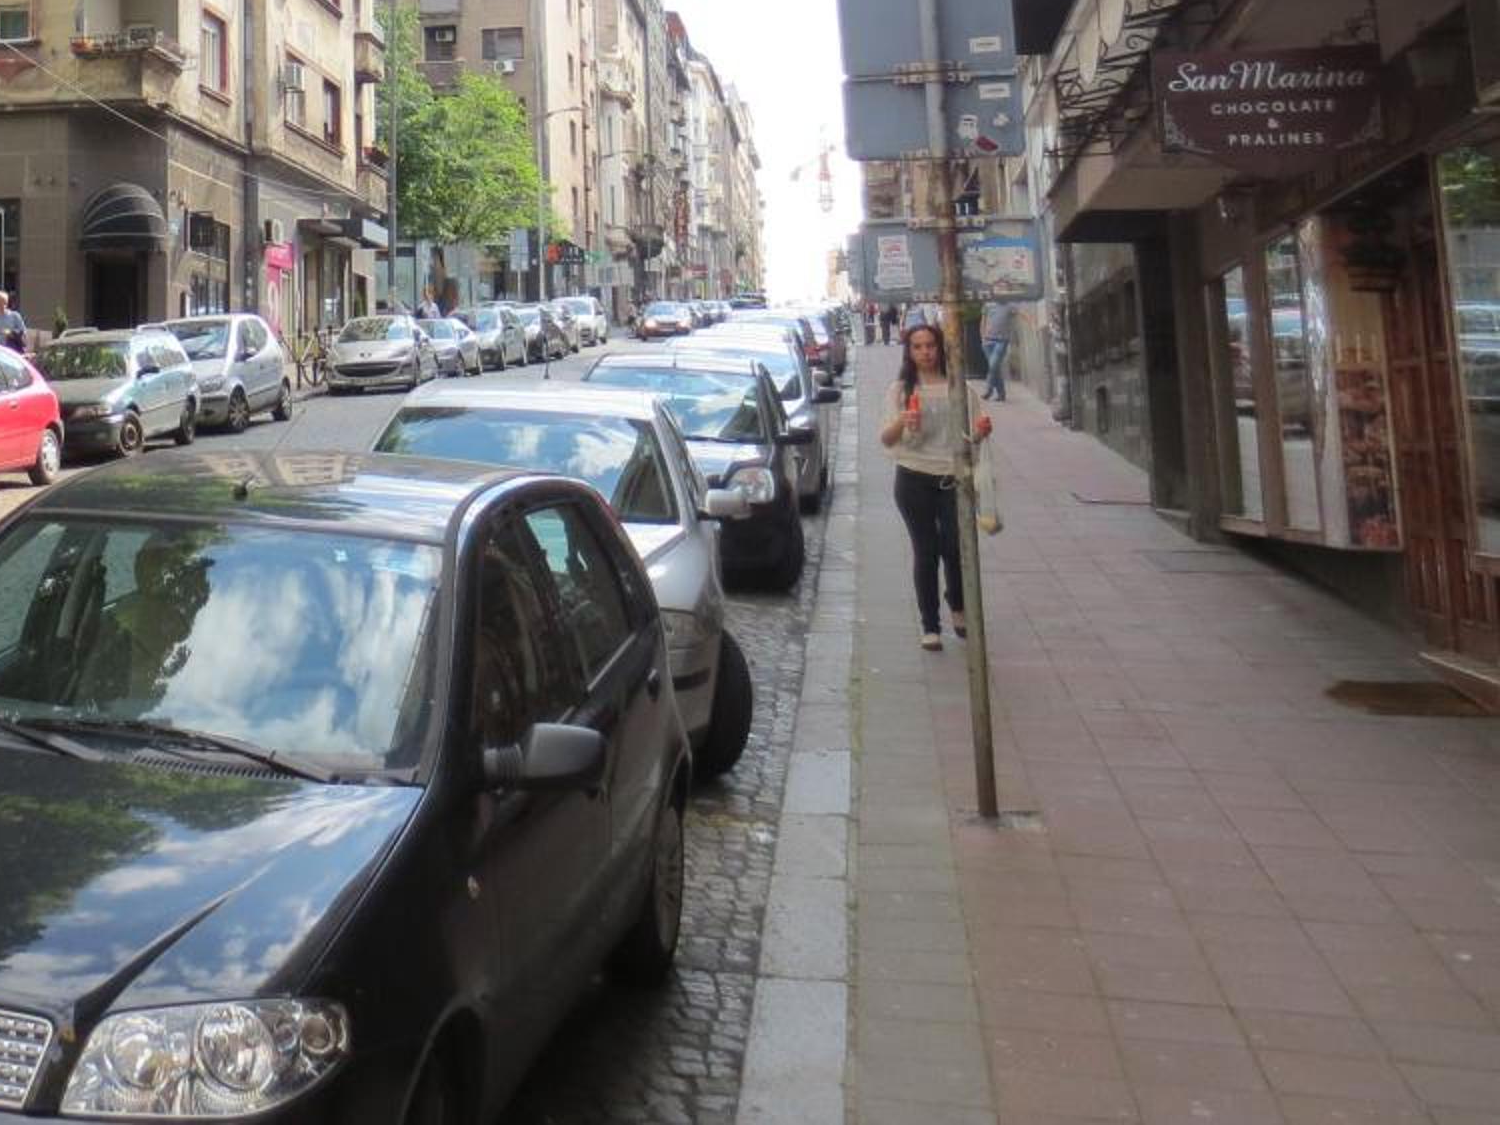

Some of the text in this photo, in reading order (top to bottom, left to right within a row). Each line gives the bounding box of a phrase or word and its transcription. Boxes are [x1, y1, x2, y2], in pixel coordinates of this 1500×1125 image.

[1168, 61, 1366, 92] San Marina
[1210, 99, 1334, 115] CHOCOLATE
[1267, 118, 1279, 129] &
[1228, 132, 1325, 146] PRALINES
